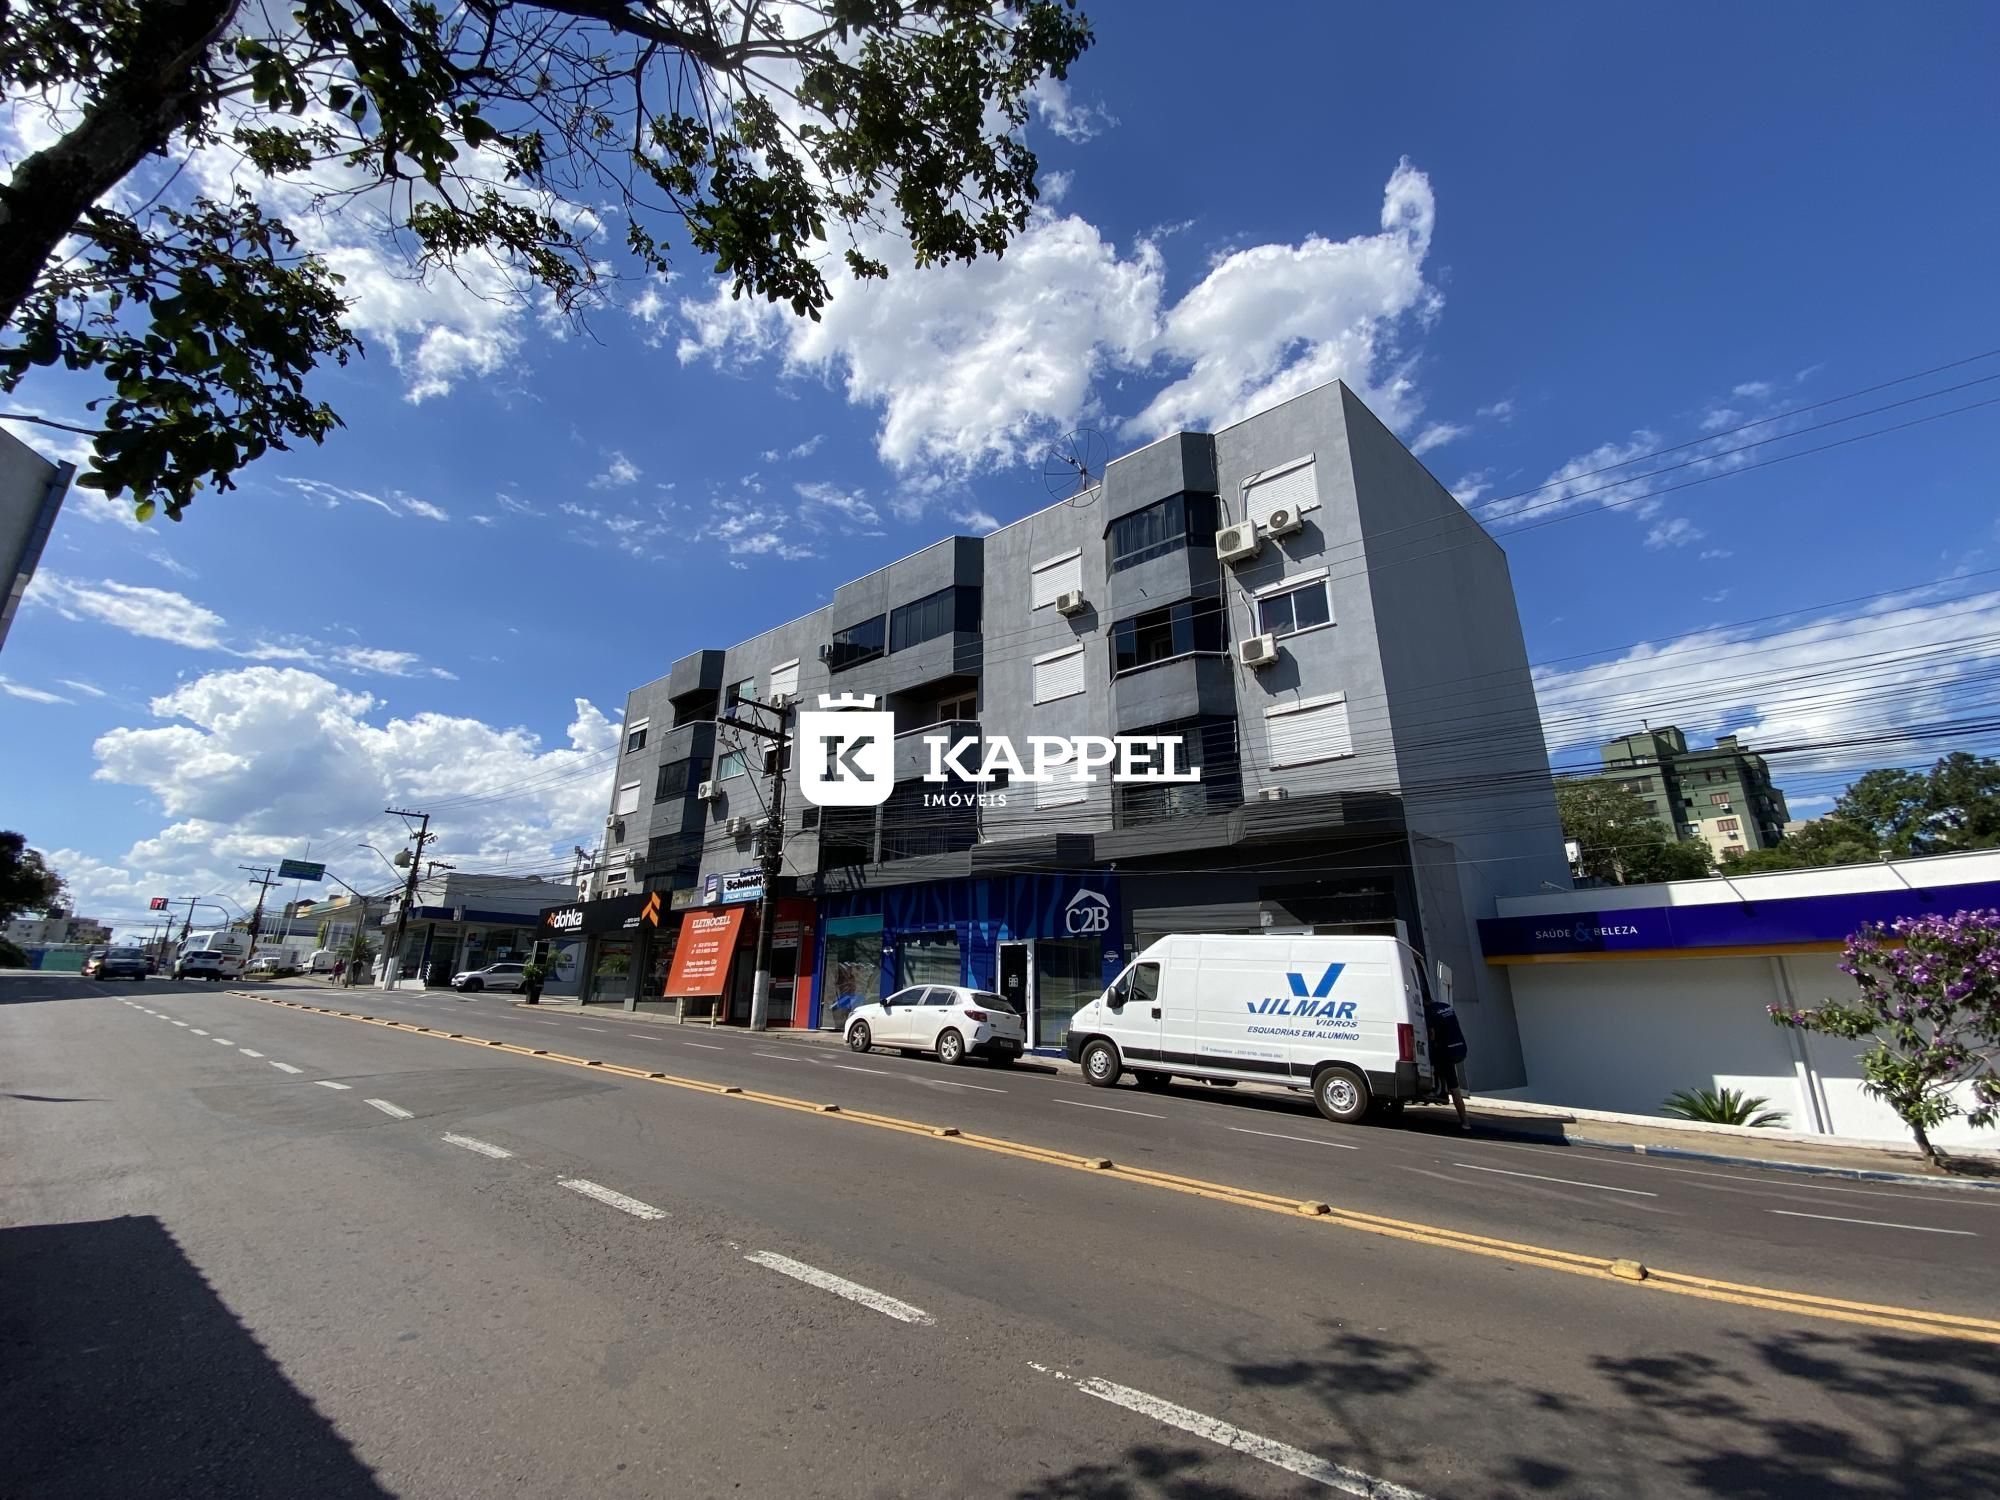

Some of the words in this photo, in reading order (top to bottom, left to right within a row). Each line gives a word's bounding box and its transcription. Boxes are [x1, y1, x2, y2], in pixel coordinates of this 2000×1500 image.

[726, 876, 762, 891] Schmidt
[554, 908, 583, 928] dohka
[1066, 907, 1109, 933] C2B
[1535, 929, 1572, 939] SAÚDE
[1594, 926, 1638, 936] BELEZA
[1247, 998, 1357, 1019] VILMAR
[1316, 1020, 1358, 1028] VIDROS
[1248, 1026, 1301, 1037] ESQUADRIAS
[1302, 1030, 1314, 1038] EM
[1316, 1031, 1360, 1041] ALUMÍNIO
